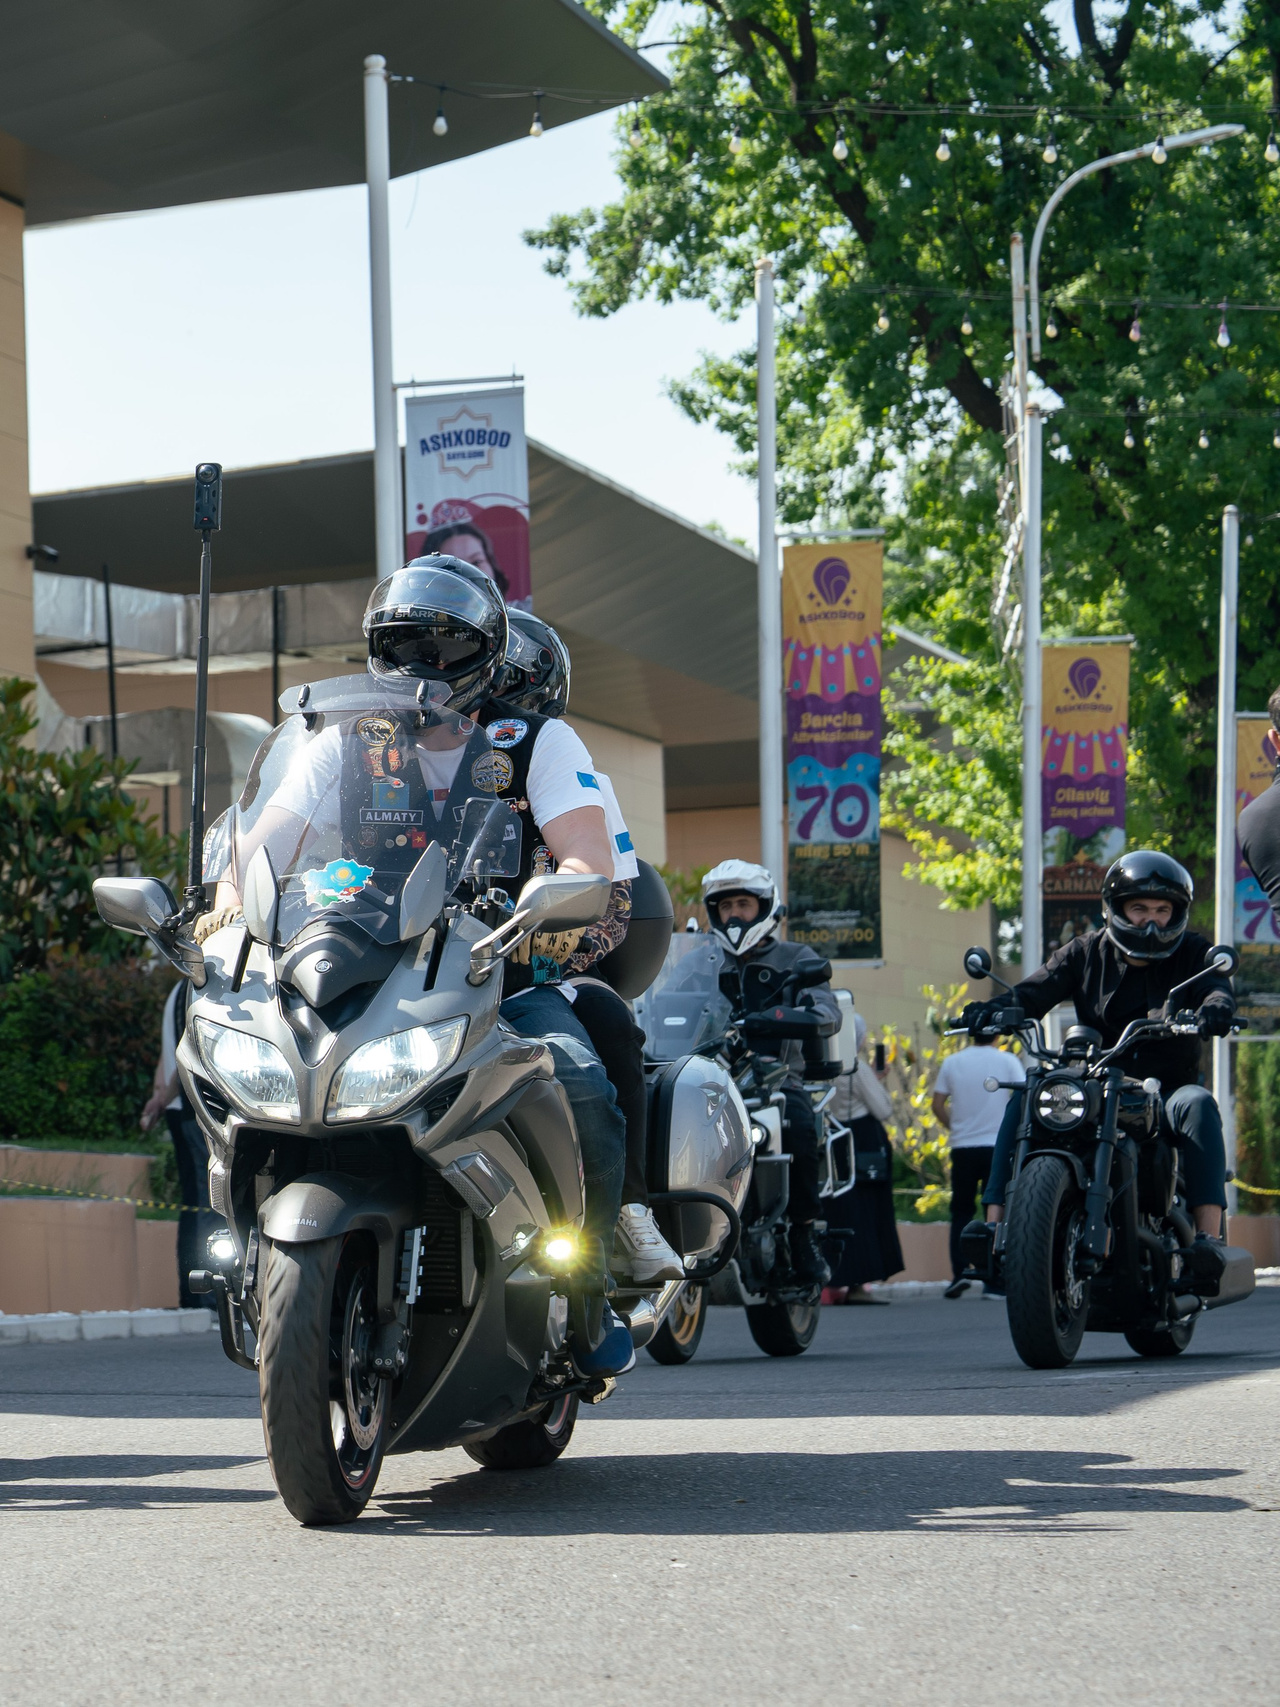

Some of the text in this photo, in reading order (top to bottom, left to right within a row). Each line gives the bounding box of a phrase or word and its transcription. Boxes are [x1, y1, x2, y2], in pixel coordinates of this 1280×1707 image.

[419, 428, 512, 456] ASHXOBOD
[394, 610, 437, 619] SHARK
[454, 676, 490, 706] SHAR
[365, 811, 417, 822] ALMATY
[796, 783, 870, 840] 70
[1044, 878, 1104, 893] CARNAV
[1243, 900, 1280, 940] 7
